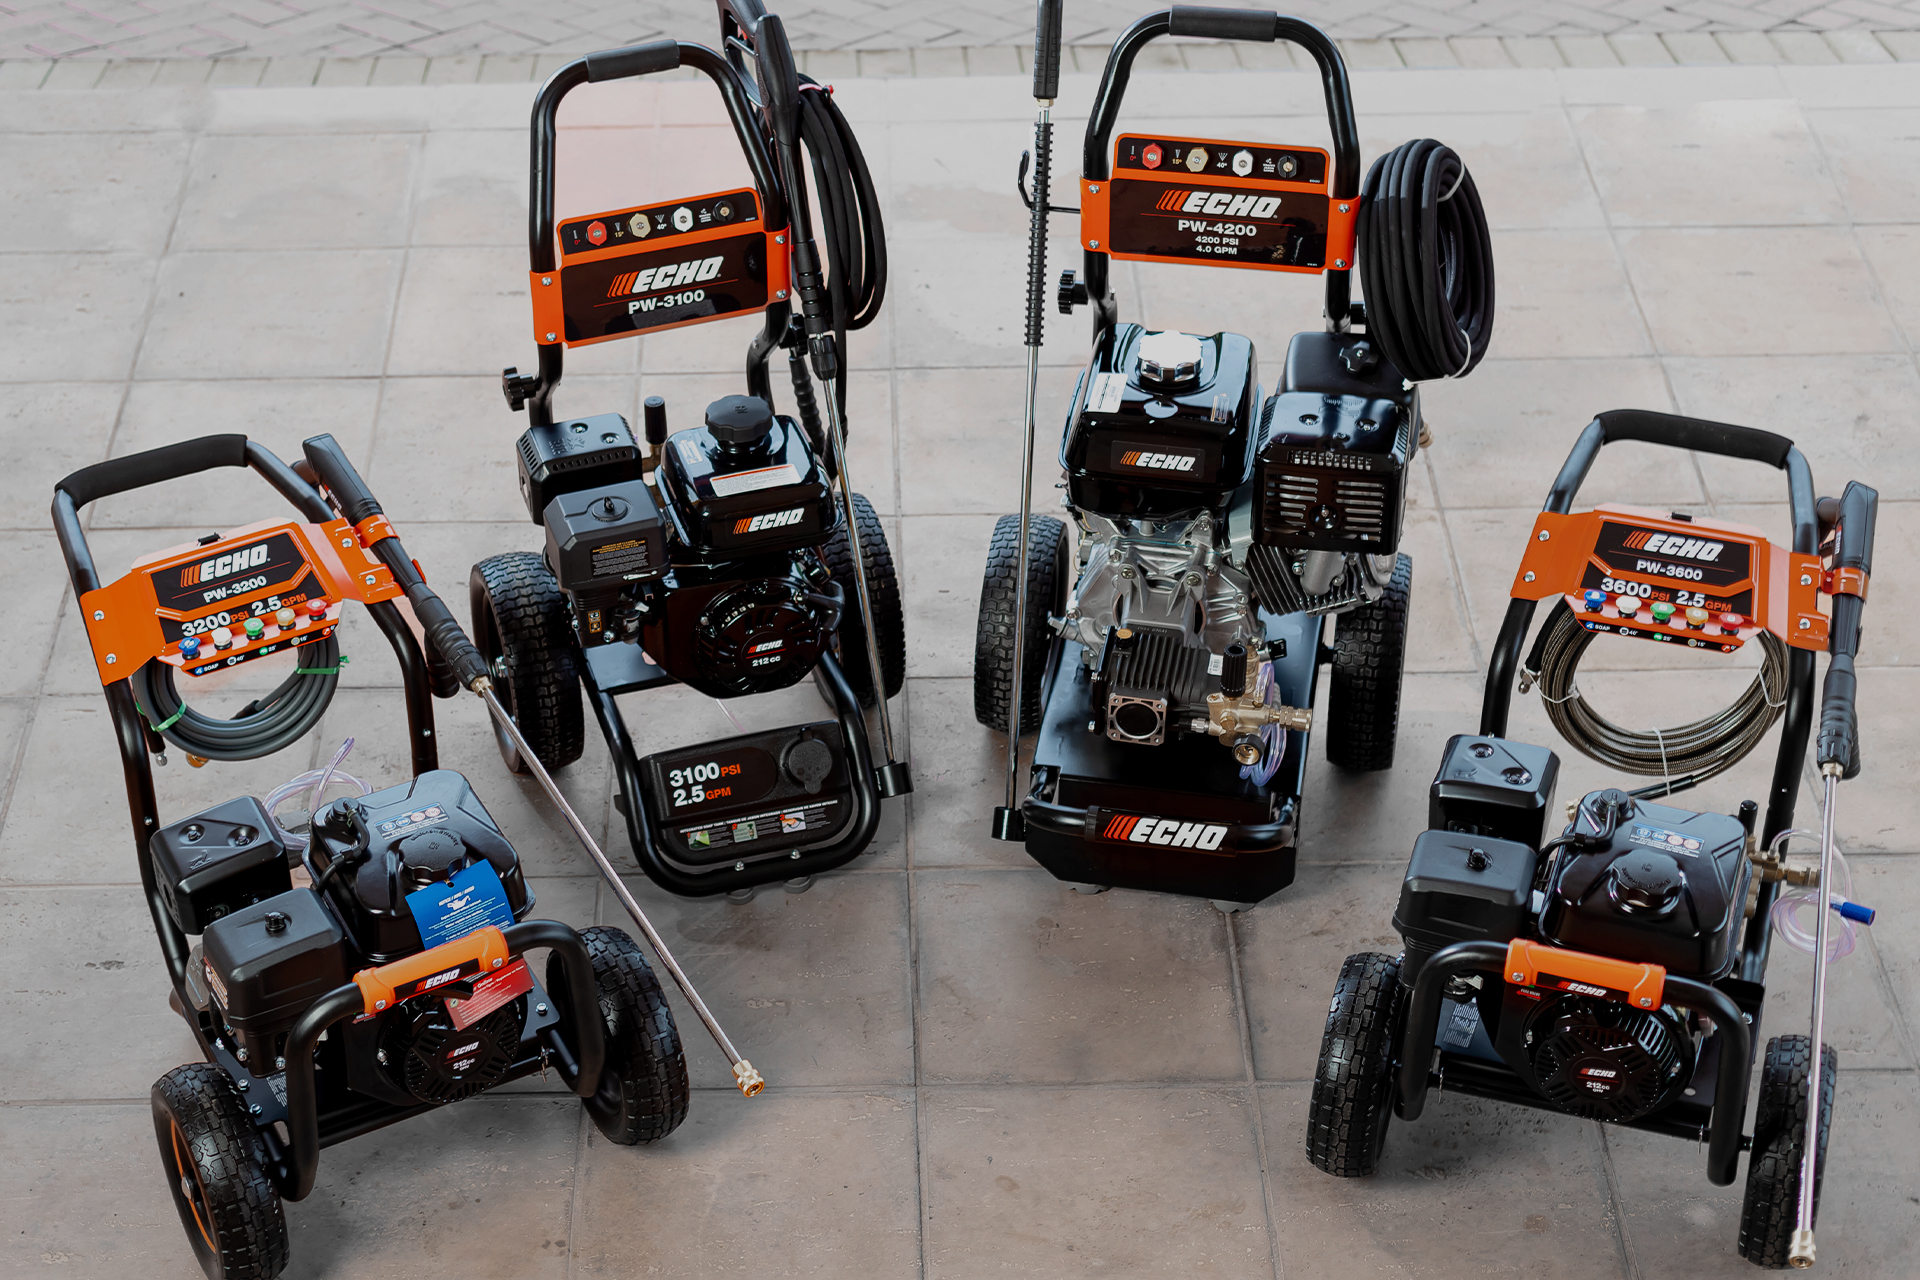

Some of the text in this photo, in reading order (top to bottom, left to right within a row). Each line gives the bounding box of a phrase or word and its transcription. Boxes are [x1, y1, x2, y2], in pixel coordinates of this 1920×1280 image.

[1181, 191, 1282, 218] ECHO
[1178, 220, 1257, 237] PW-4200
[1195, 236, 1239, 246] 4200 PSI
[1196, 245, 1238, 255] 4.0 GPM
[632, 256, 724, 294] ECHO
[628, 290, 705, 314] PW-3100
[1136, 452, 1196, 472] ECHO
[748, 507, 805, 532] ECHO
[1644, 532, 1724, 562] ECHO
[200, 544, 268, 582] ECHO
[1636, 558, 1703, 581] PW-3600
[203, 575, 267, 603] PW-3200
[1600, 576, 1732, 612] 3600 PSI 2.5 GPM
[181, 593, 307, 636] 3200 PSI 2.5 GPM
[756, 639, 783, 652] ECHO
[203, 663, 219, 672] SOAP
[669, 762, 741, 788] 3100 PSI
[673, 785, 731, 807] 2.5 GPM
[1129, 817, 1228, 850] ECHO
[425, 968, 460, 989] ECHO
[1567, 983, 1607, 996] ECHO
[453, 1041, 479, 1057] ECHO
[1587, 1068, 1616, 1078] ECHO
